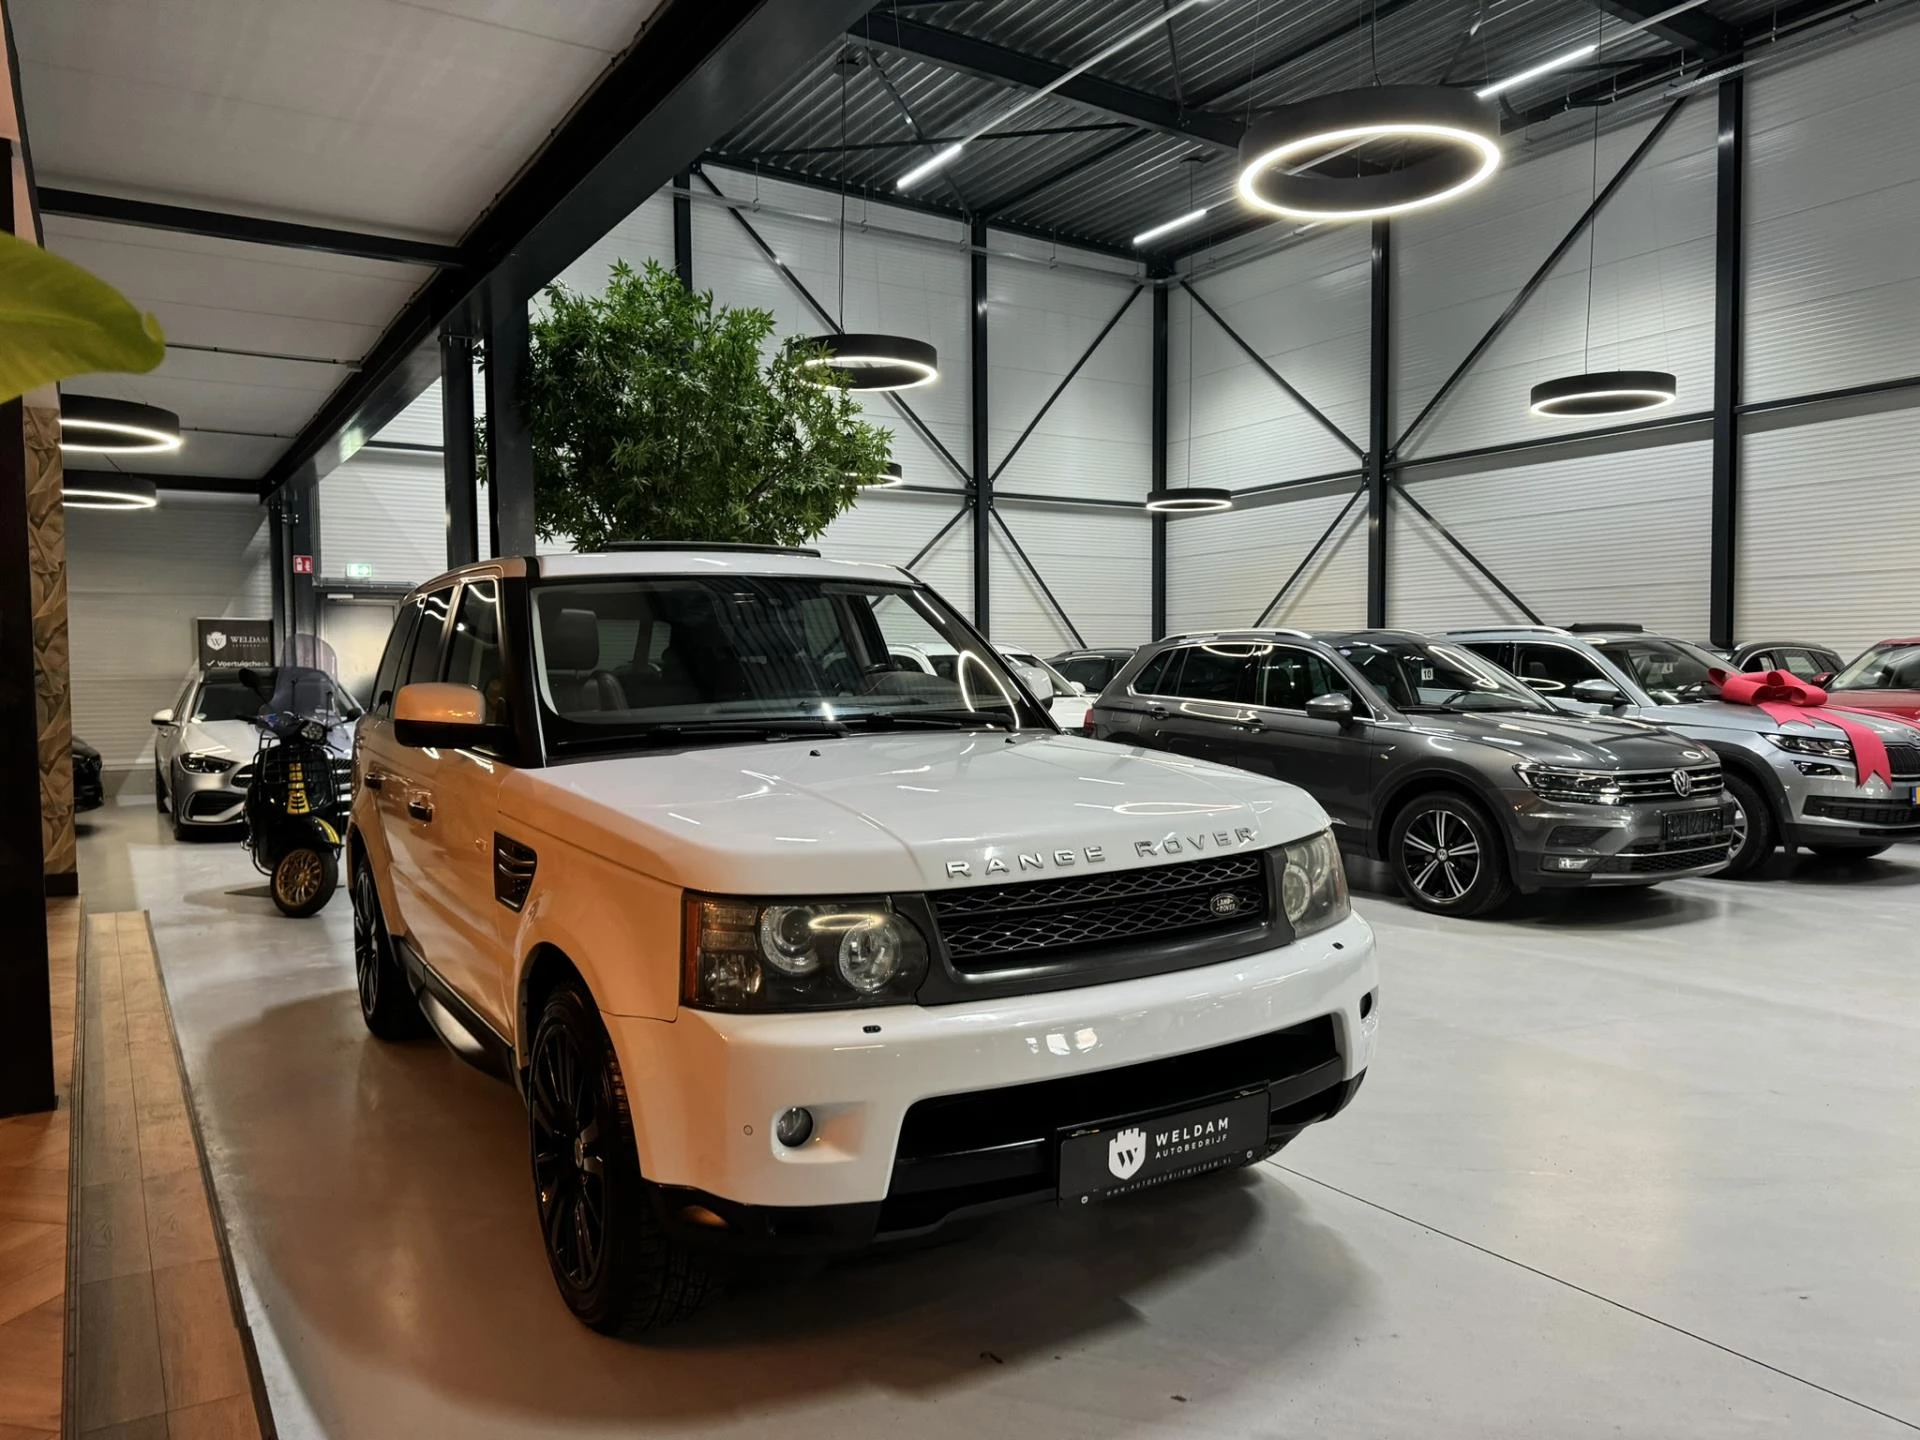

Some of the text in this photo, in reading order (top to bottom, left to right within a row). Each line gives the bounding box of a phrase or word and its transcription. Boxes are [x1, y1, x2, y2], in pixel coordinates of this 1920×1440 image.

[230, 635, 269, 643] WELDAM
[945, 827, 1255, 878] RANGE ROVER
[1156, 1117, 1229, 1147] WELDAM
[1156, 1133, 1228, 1159] AUTOBEDRIJF
